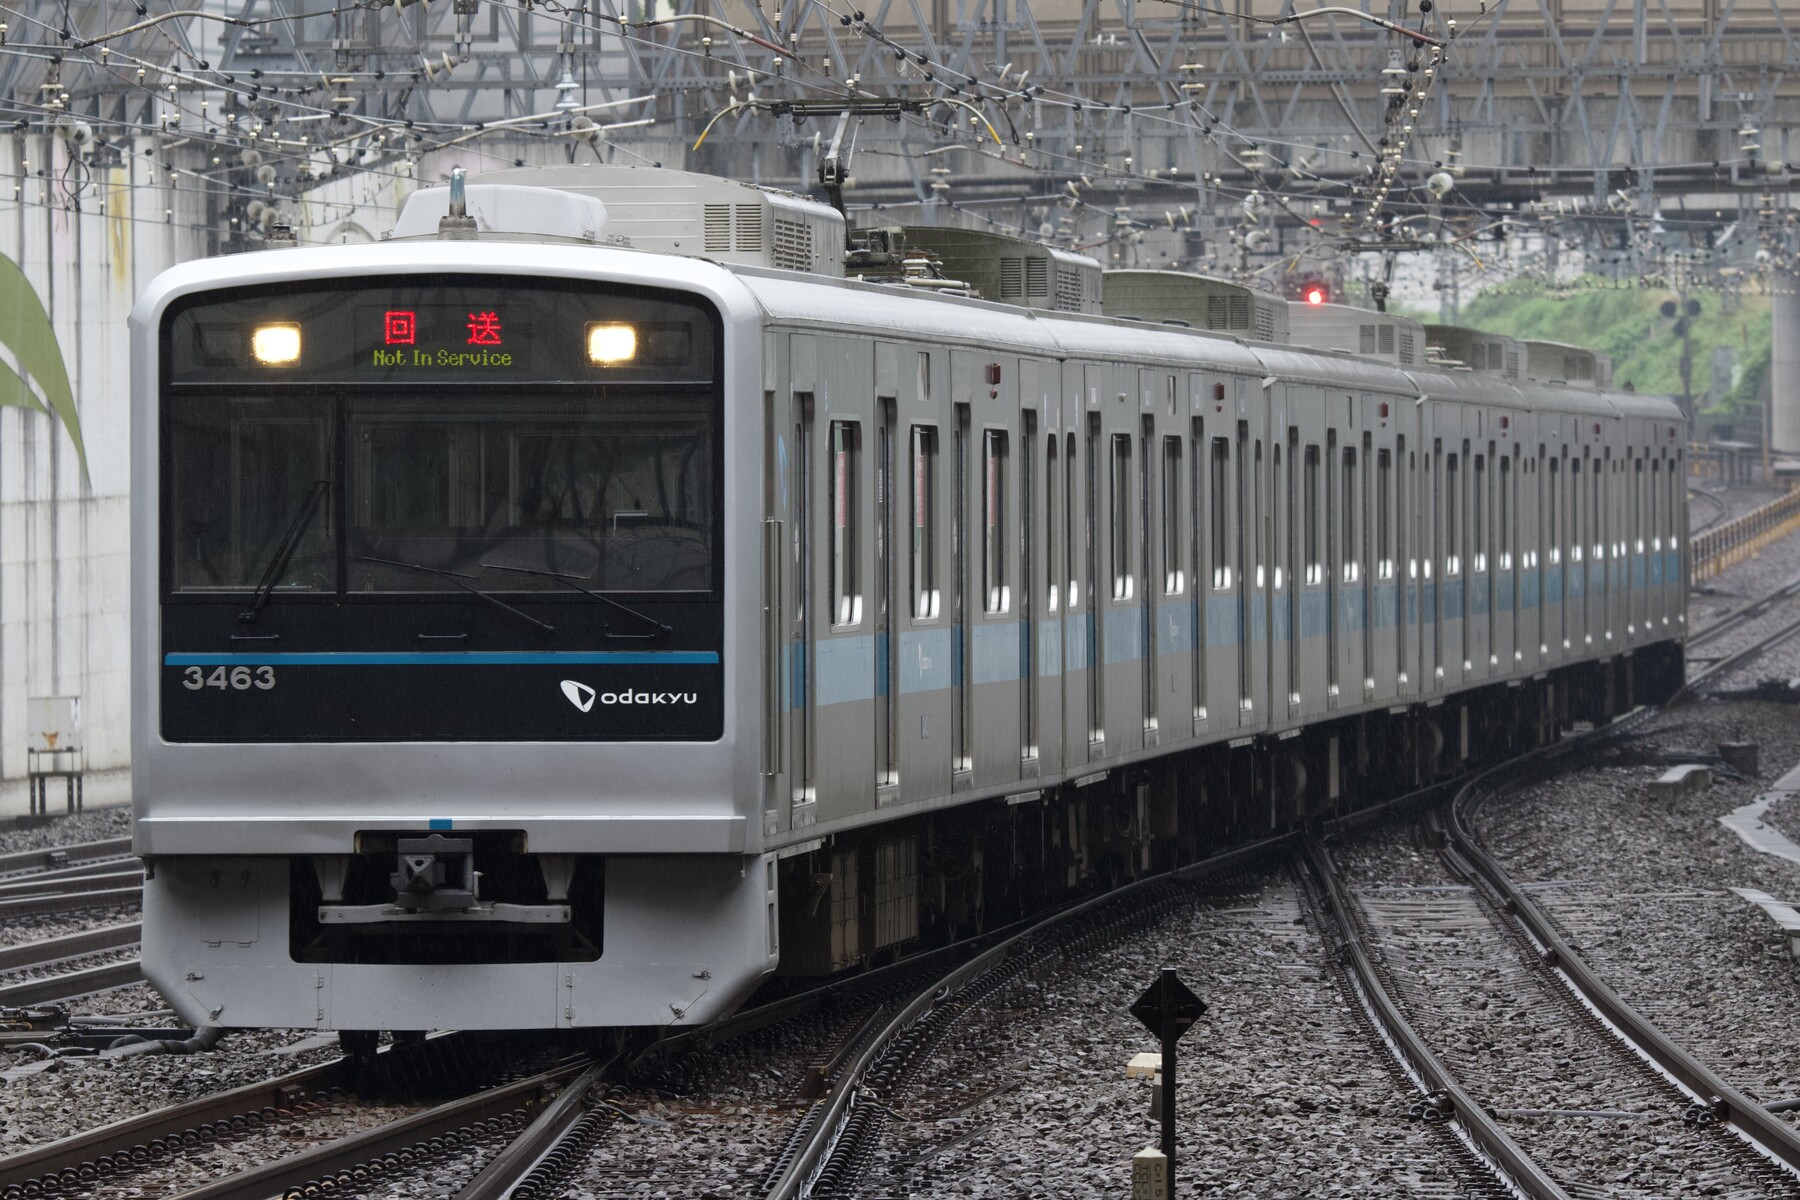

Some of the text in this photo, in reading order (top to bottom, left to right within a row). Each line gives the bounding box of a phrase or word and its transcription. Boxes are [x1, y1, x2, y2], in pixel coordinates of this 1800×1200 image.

[373, 350, 513, 367] Not In Service
[182, 665, 276, 691] 3463
[600, 688, 698, 705] odakyu
